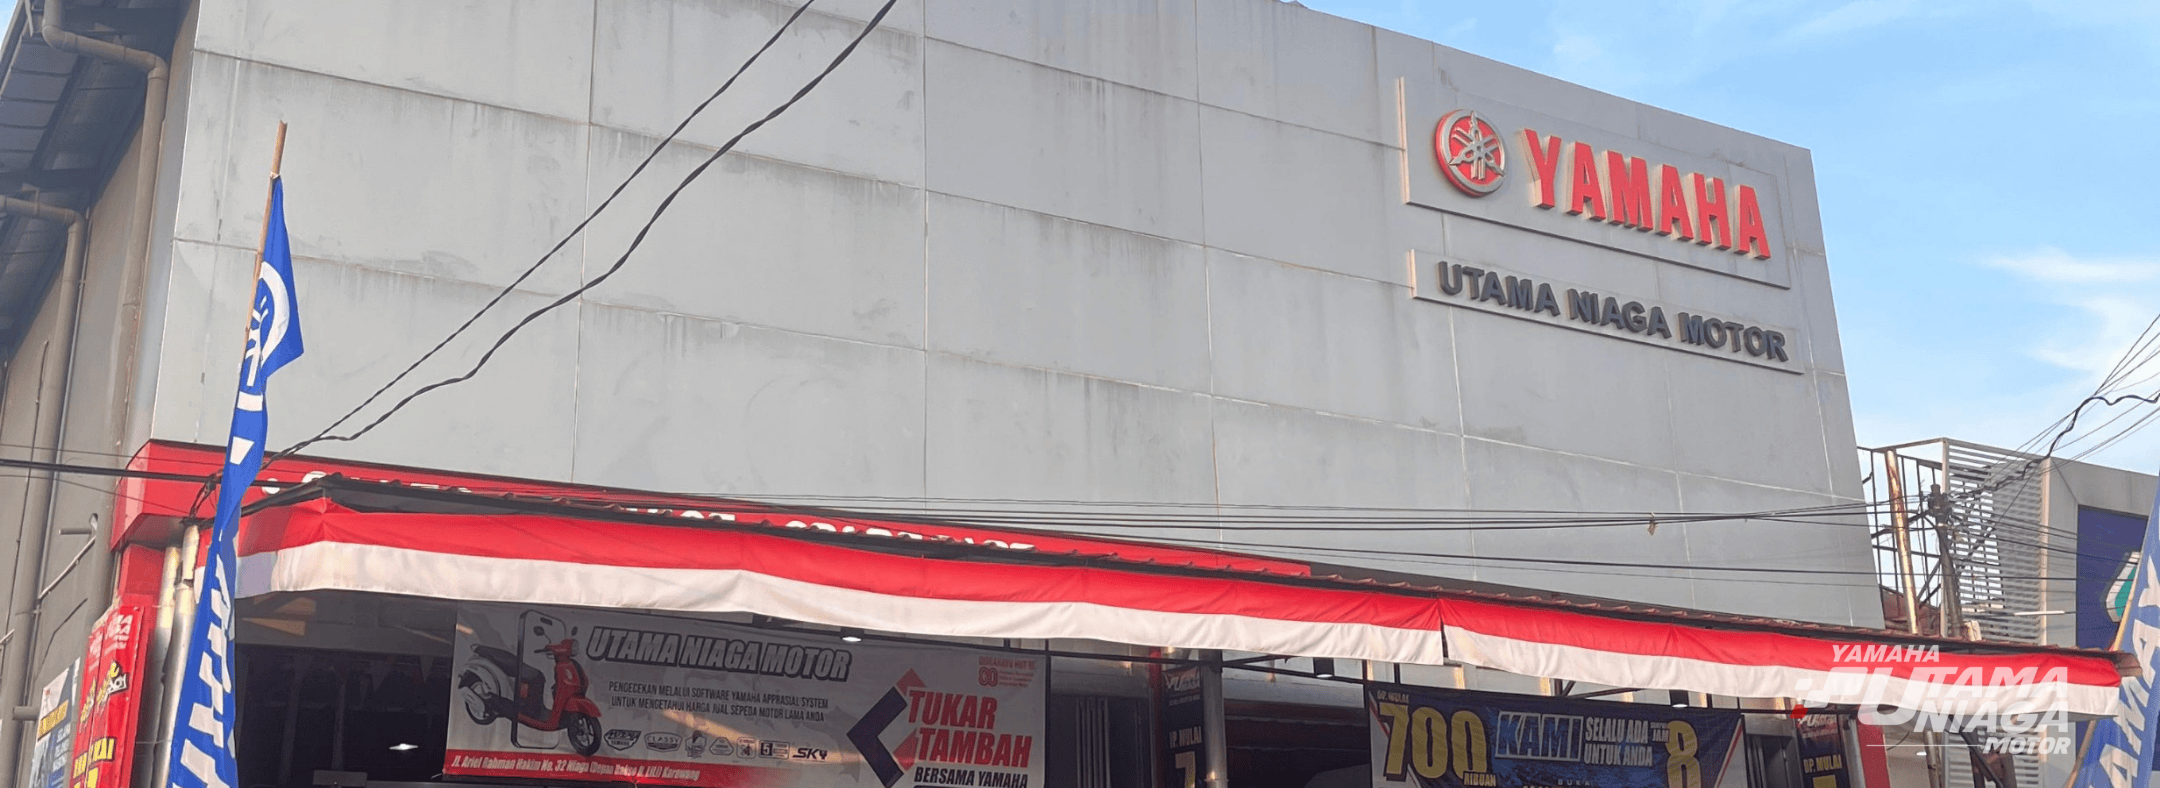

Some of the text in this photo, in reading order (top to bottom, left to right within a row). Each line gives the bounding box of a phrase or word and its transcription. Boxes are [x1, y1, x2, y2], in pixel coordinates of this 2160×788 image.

[1522, 128, 1772, 261] YAMAHA
[1438, 261, 1789, 363] UTAMA NIAGA MOTOR
[586, 626, 852, 682] UTAMA NIAGA MOTOR
[608, 681, 657, 695] PENGECEKAN
[659, 685, 691, 698] MELALUI
[691, 687, 730, 701] SOFTWARE
[731, 691, 761, 704] YAMAHA
[801, 697, 828, 709] SYSTEM
[611, 696, 636, 708] UNTUK
[685, 701, 710, 713] HARGA
[711, 703, 729, 715] JUAL
[730, 705, 758, 717] SEPEDA
[759, 707, 784, 719] MOTOR
[784, 710, 805, 721] LAMA
[805, 711, 825, 722] ANDA
[908, 690, 998, 730] TUKAR
[647, 735, 680, 743] CLASSY
[1378, 701, 1488, 780] 700
[1495, 711, 1584, 762] KAMI
[1585, 717, 1650, 744] SELALU ADA
[792, 748, 828, 760] SKY
[918, 727, 1033, 769] TAMBAH
[1584, 743, 1653, 767] UNTUK ANDA
[1665, 720, 1702, 788] 8
[555, 760, 568, 772] 32
[1816, 754, 1843, 772] MULAI
[914, 767, 1029, 788] BERSAMA YAMAHA
[1557, 778, 1590, 787] BUKA
